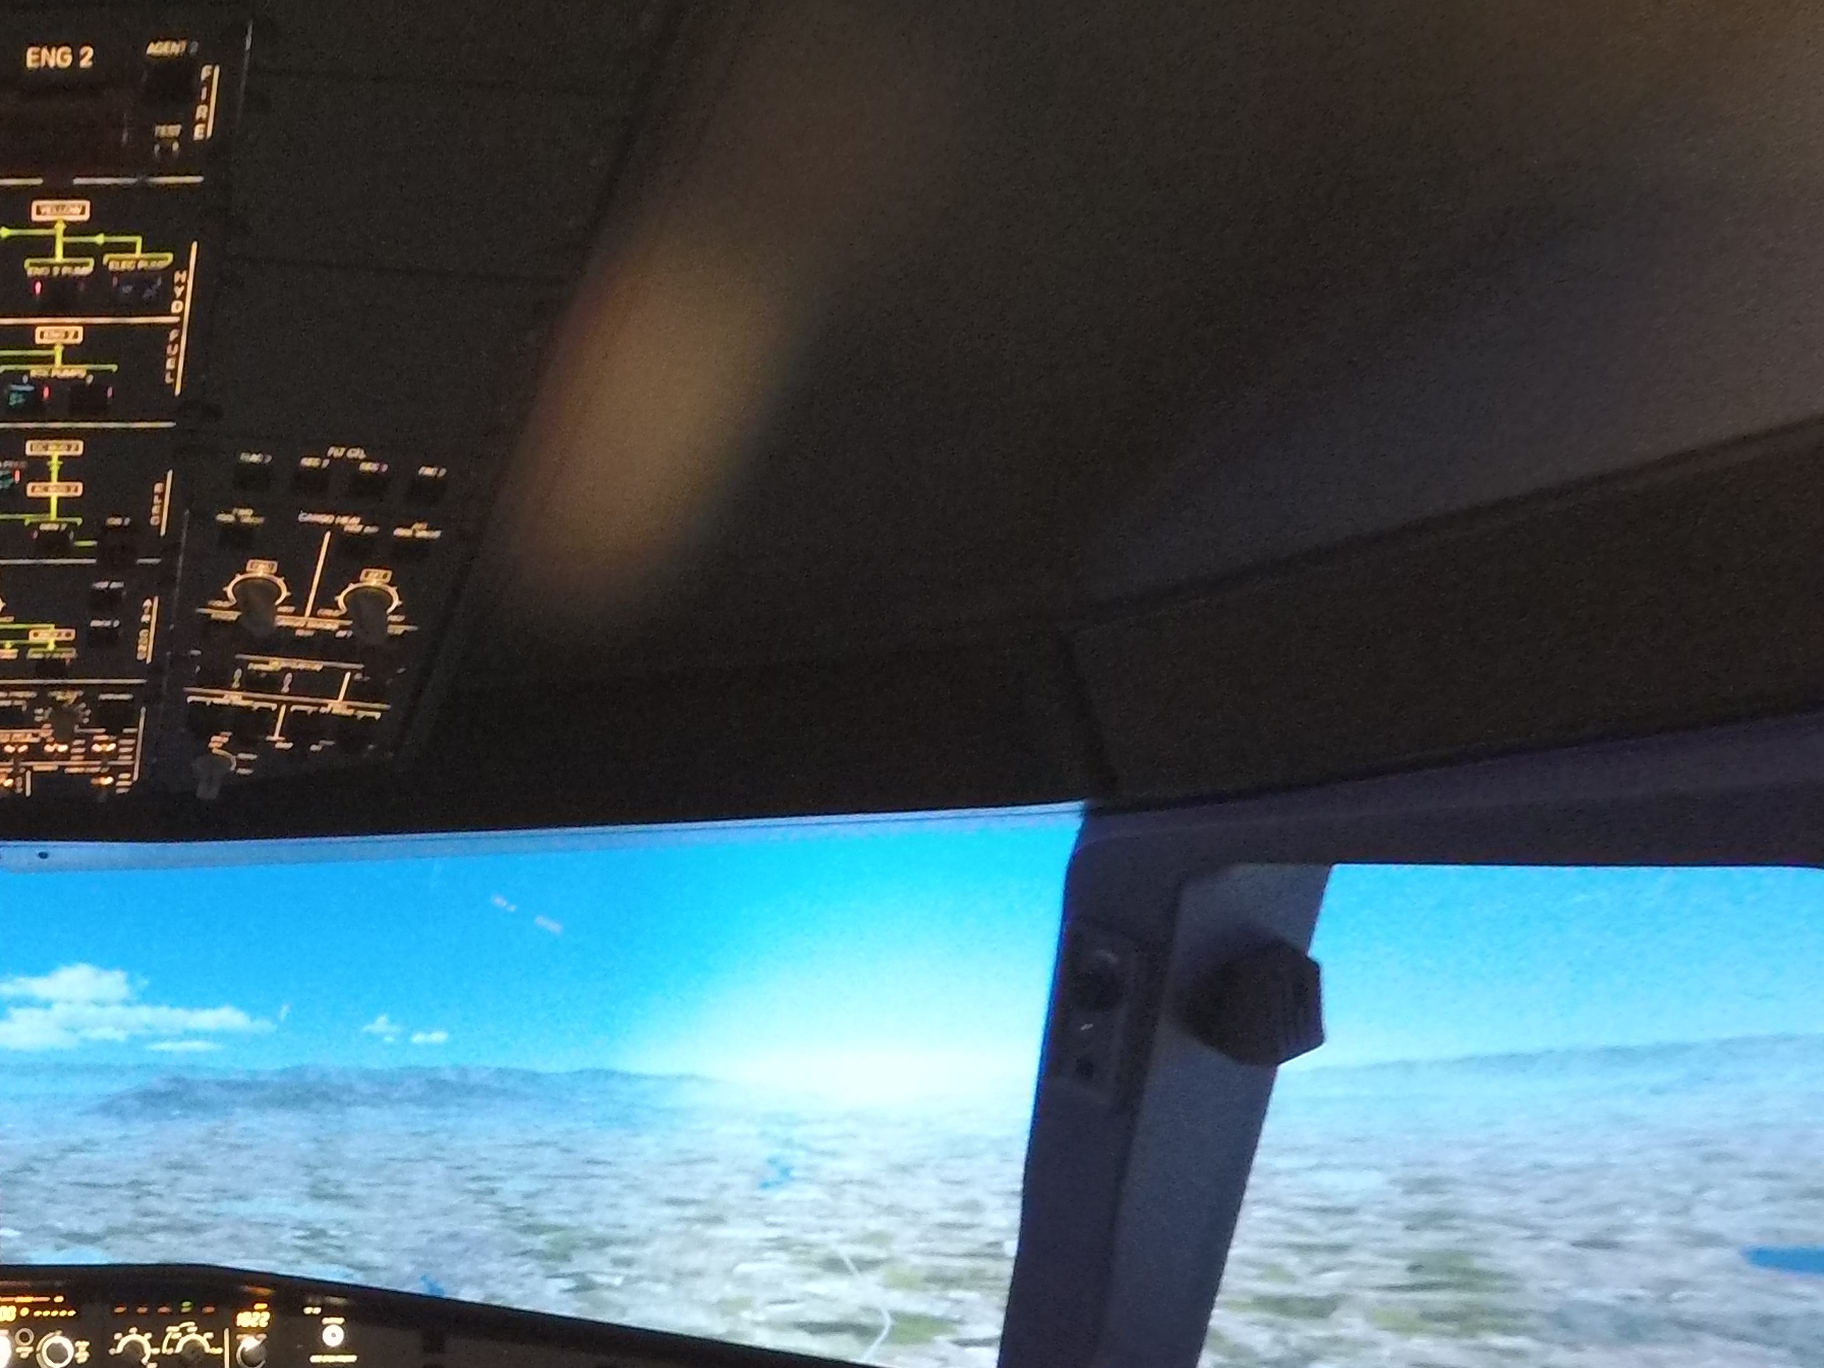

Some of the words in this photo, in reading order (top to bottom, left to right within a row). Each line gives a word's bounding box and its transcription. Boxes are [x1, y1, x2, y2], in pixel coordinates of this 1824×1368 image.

[26, 46, 73, 69] ENG
[79, 46, 94, 68] 2
[193, 65, 213, 141] FIRE
